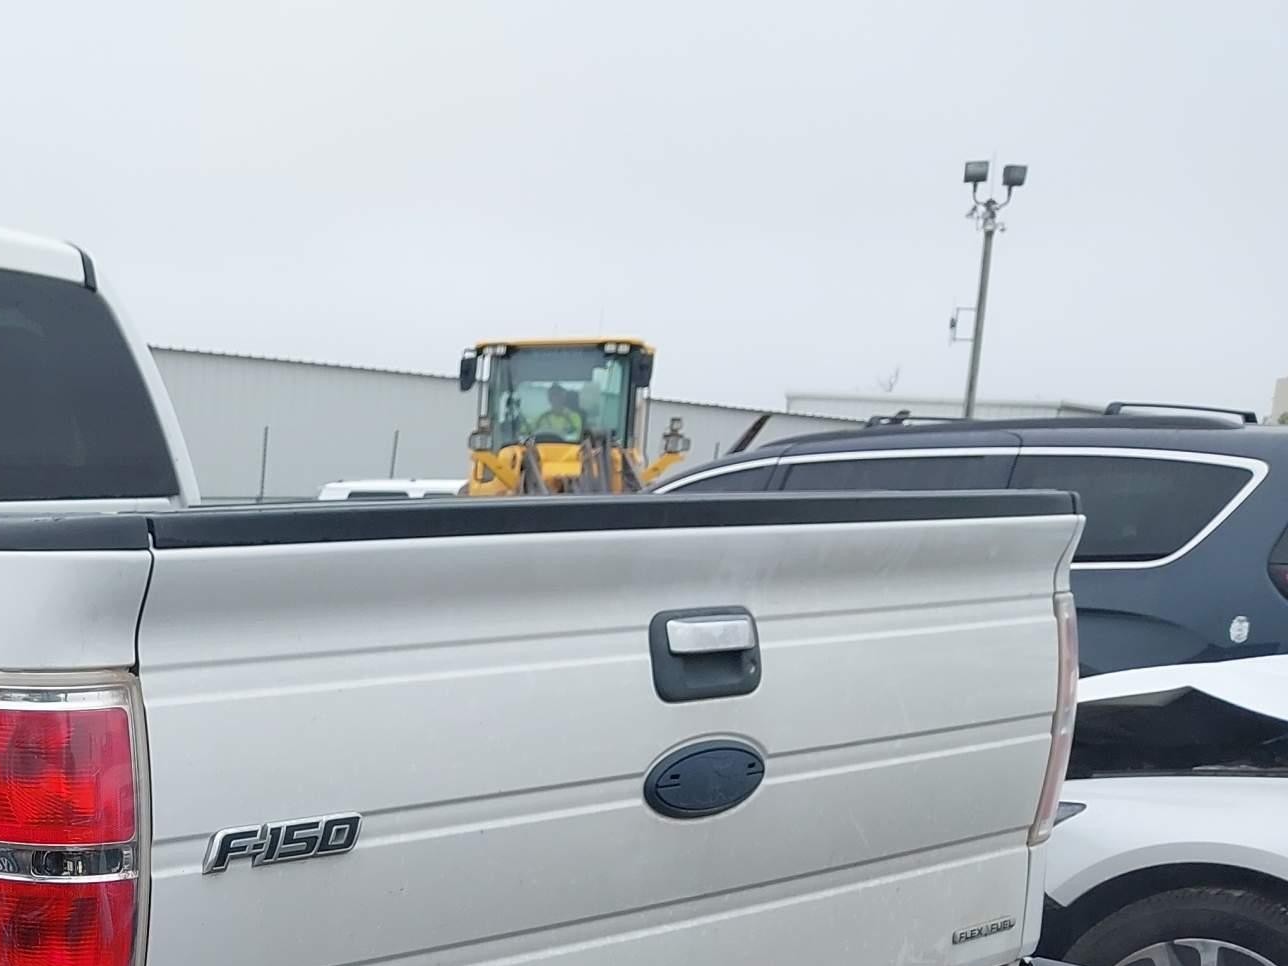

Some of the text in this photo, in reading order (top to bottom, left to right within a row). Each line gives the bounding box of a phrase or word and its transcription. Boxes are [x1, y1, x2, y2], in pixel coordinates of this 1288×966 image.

[202, 811, 362, 874] F-150
[958, 918, 1015, 943] FLEX FUEL
